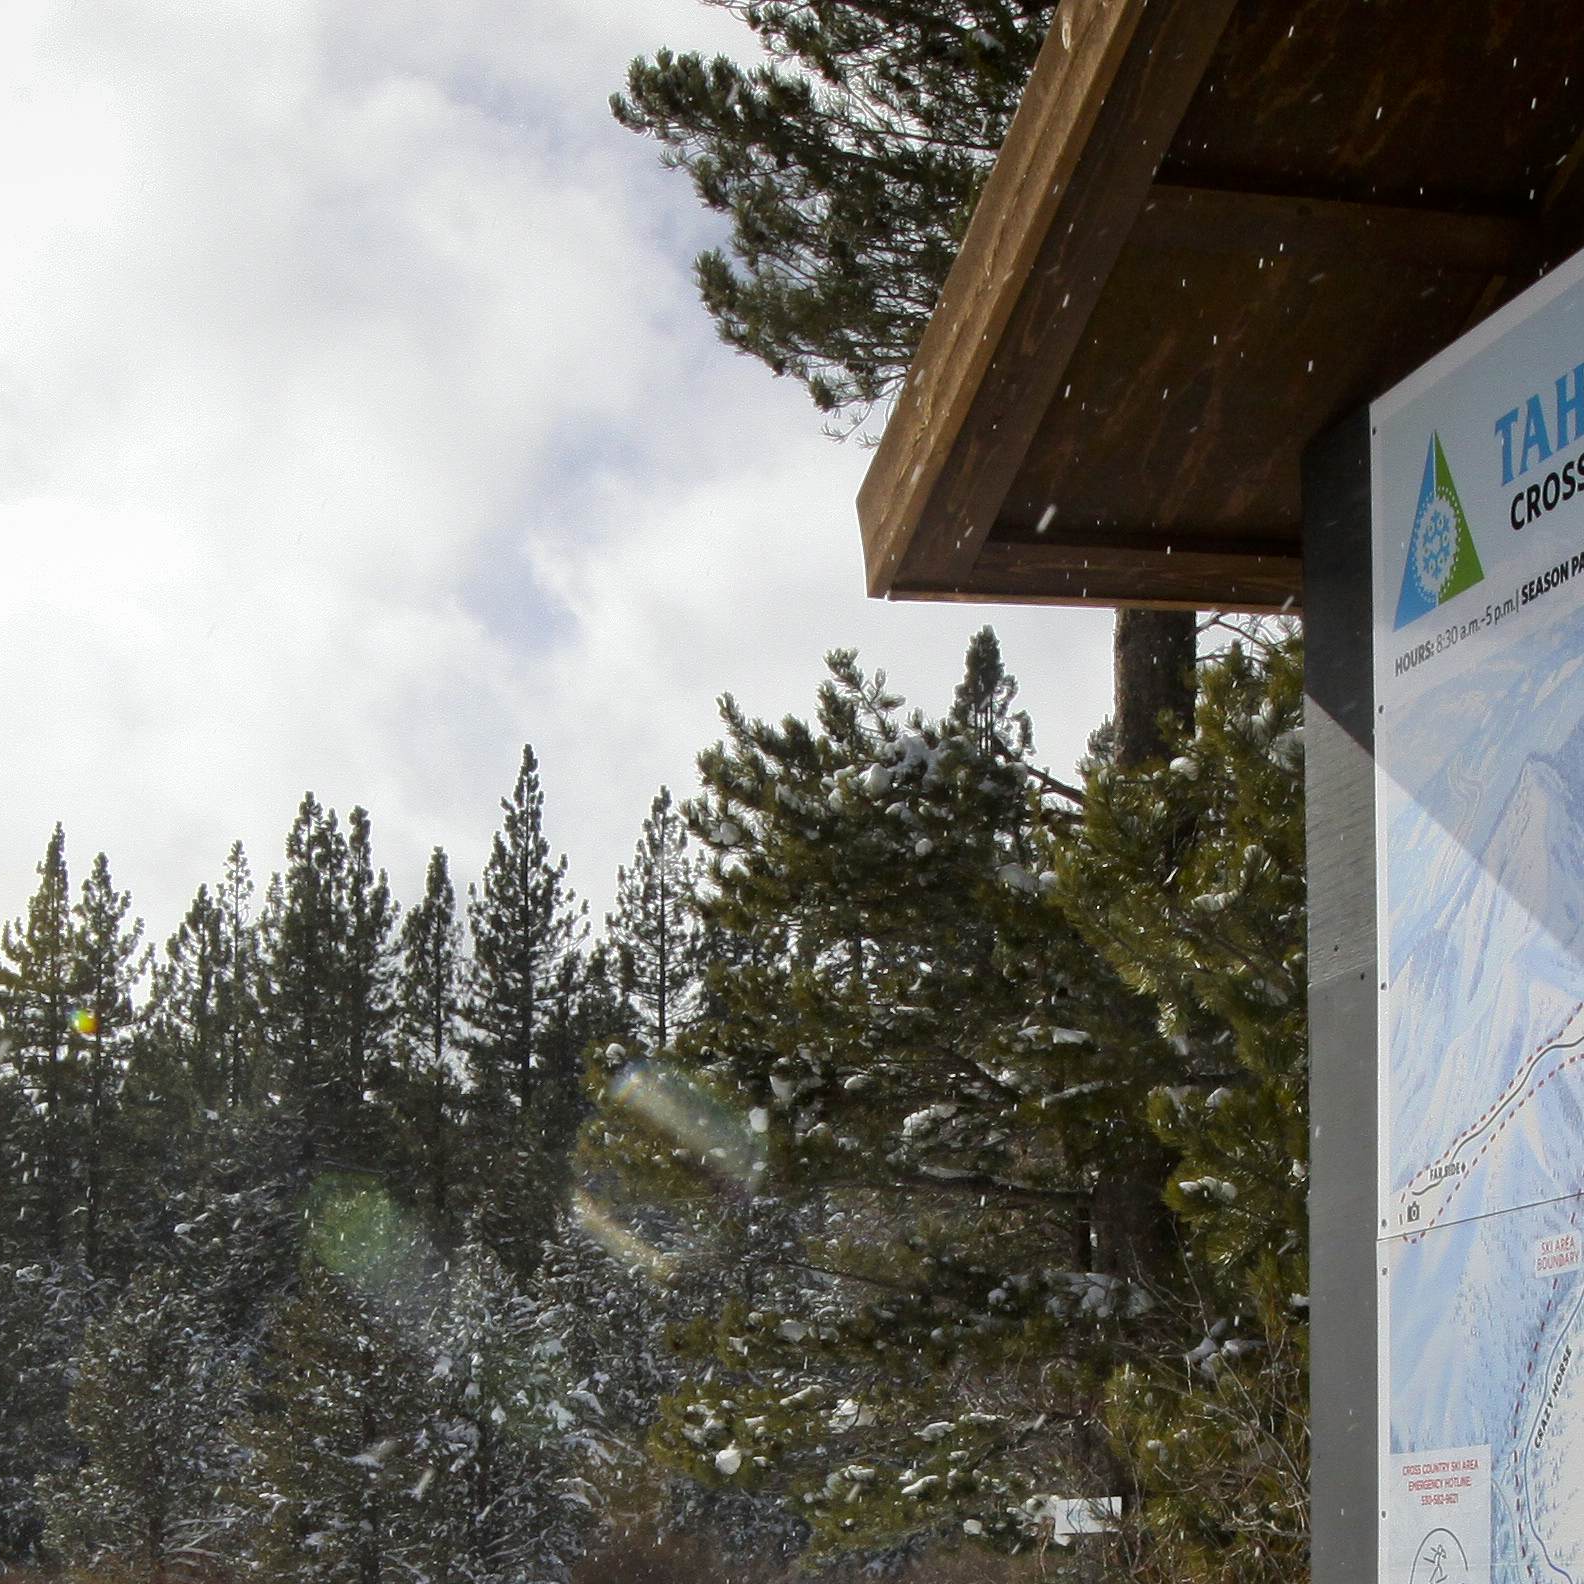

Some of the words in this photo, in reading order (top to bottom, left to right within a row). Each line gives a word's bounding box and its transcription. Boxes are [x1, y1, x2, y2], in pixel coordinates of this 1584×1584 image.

[1395, 640, 1435, 677] HOURS:
[1436, 625, 1458, 653] 8:30
[1520, 560, 1569, 606] SEASON
